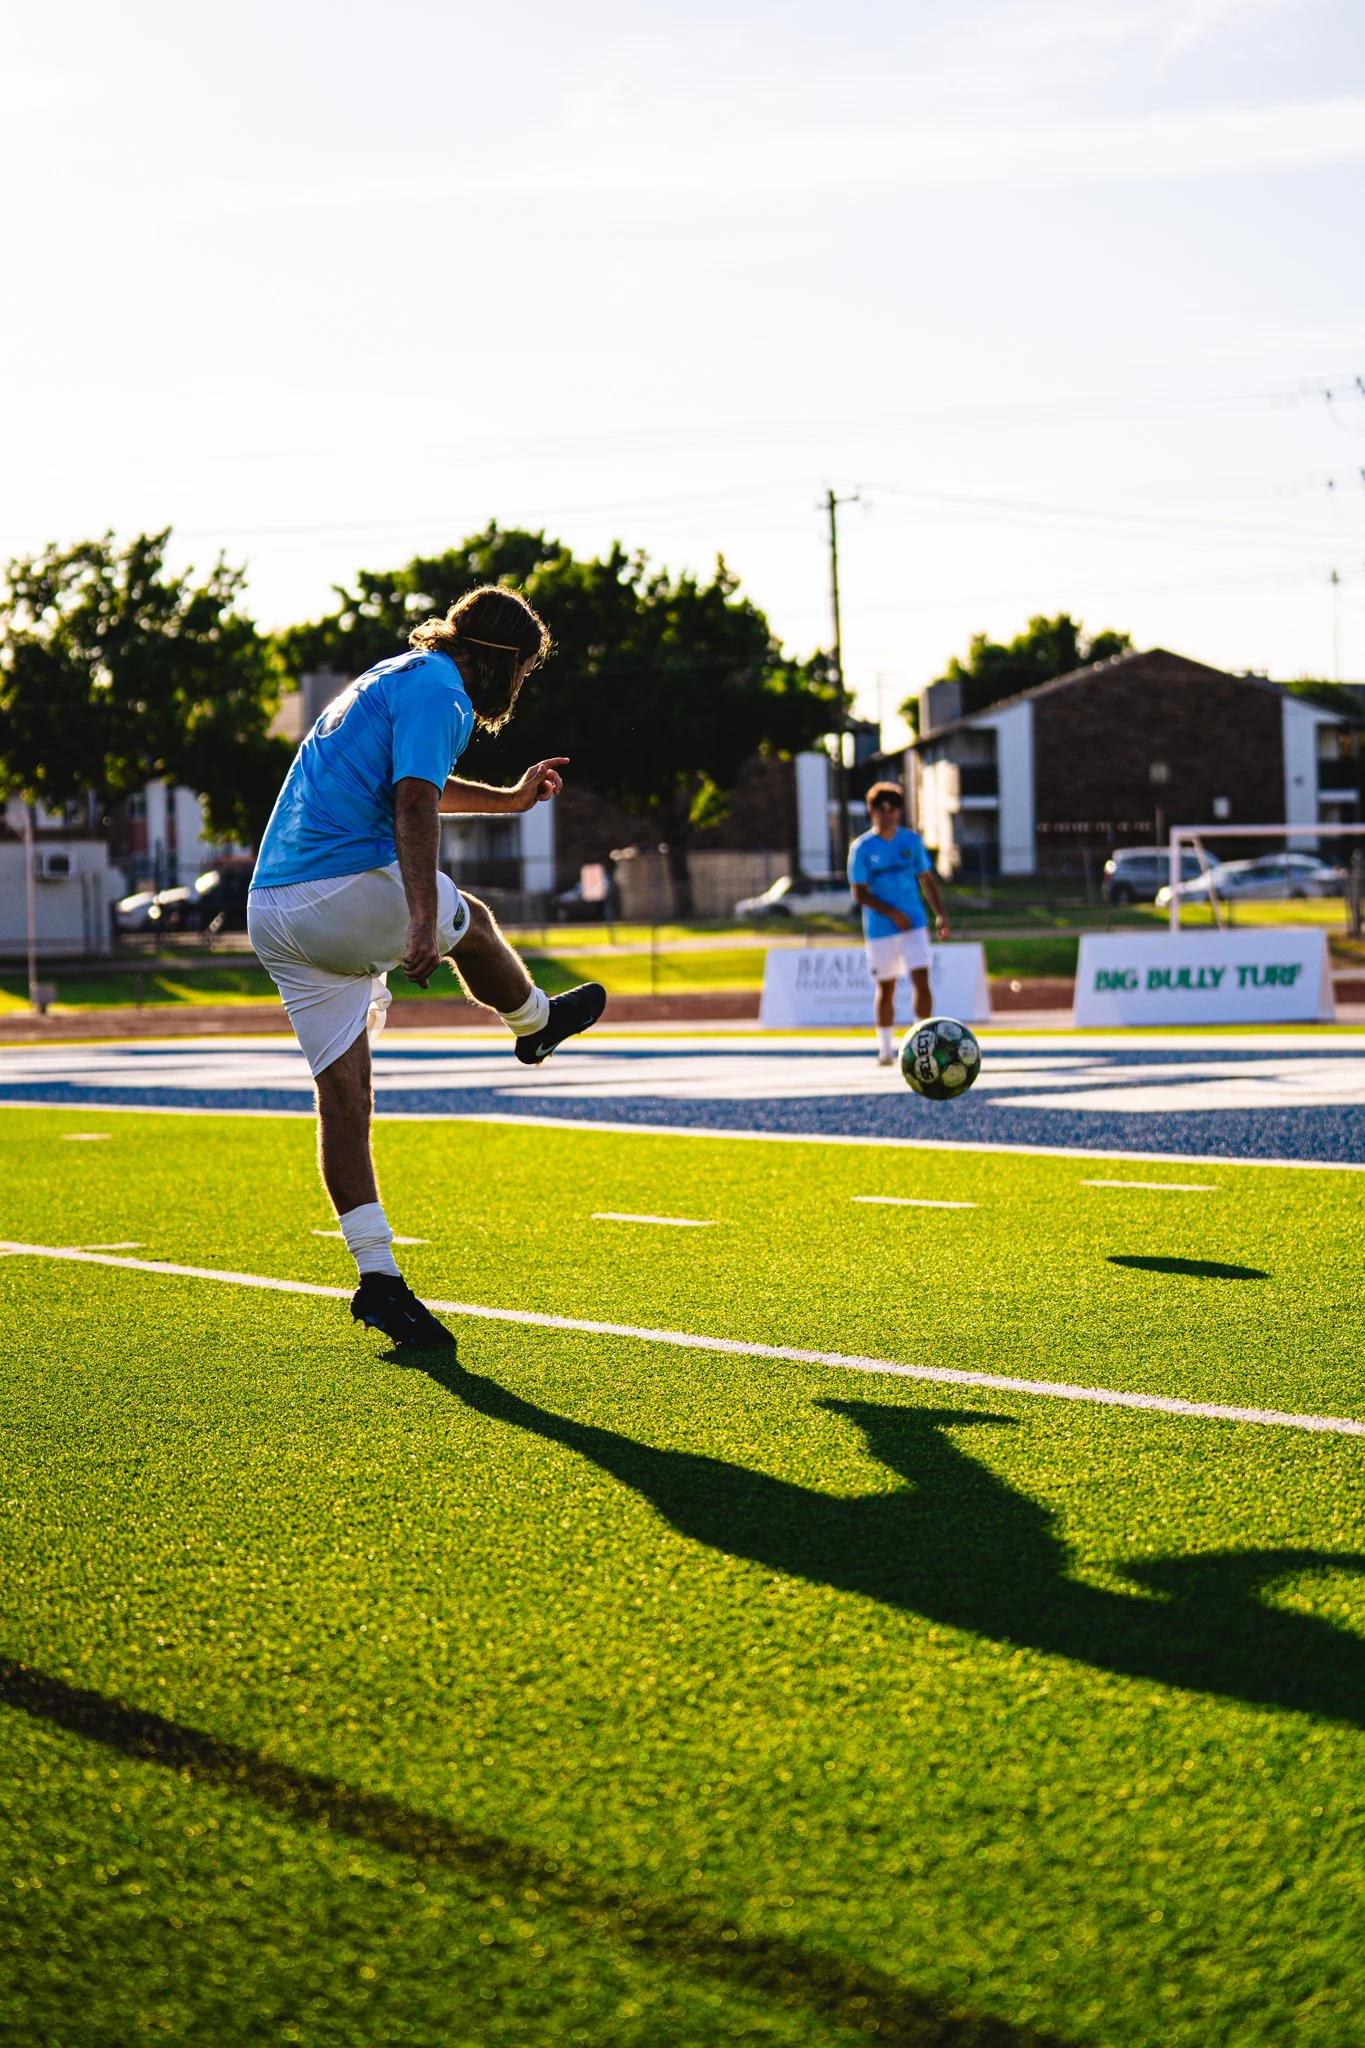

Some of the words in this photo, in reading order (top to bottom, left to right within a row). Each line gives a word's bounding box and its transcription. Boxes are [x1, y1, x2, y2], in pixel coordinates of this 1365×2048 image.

[1094, 968, 1139, 992] BIG
[1146, 966, 1226, 991] BULLY
[1236, 962, 1303, 989] TURF
[917, 1033, 935, 1081] SELECT
